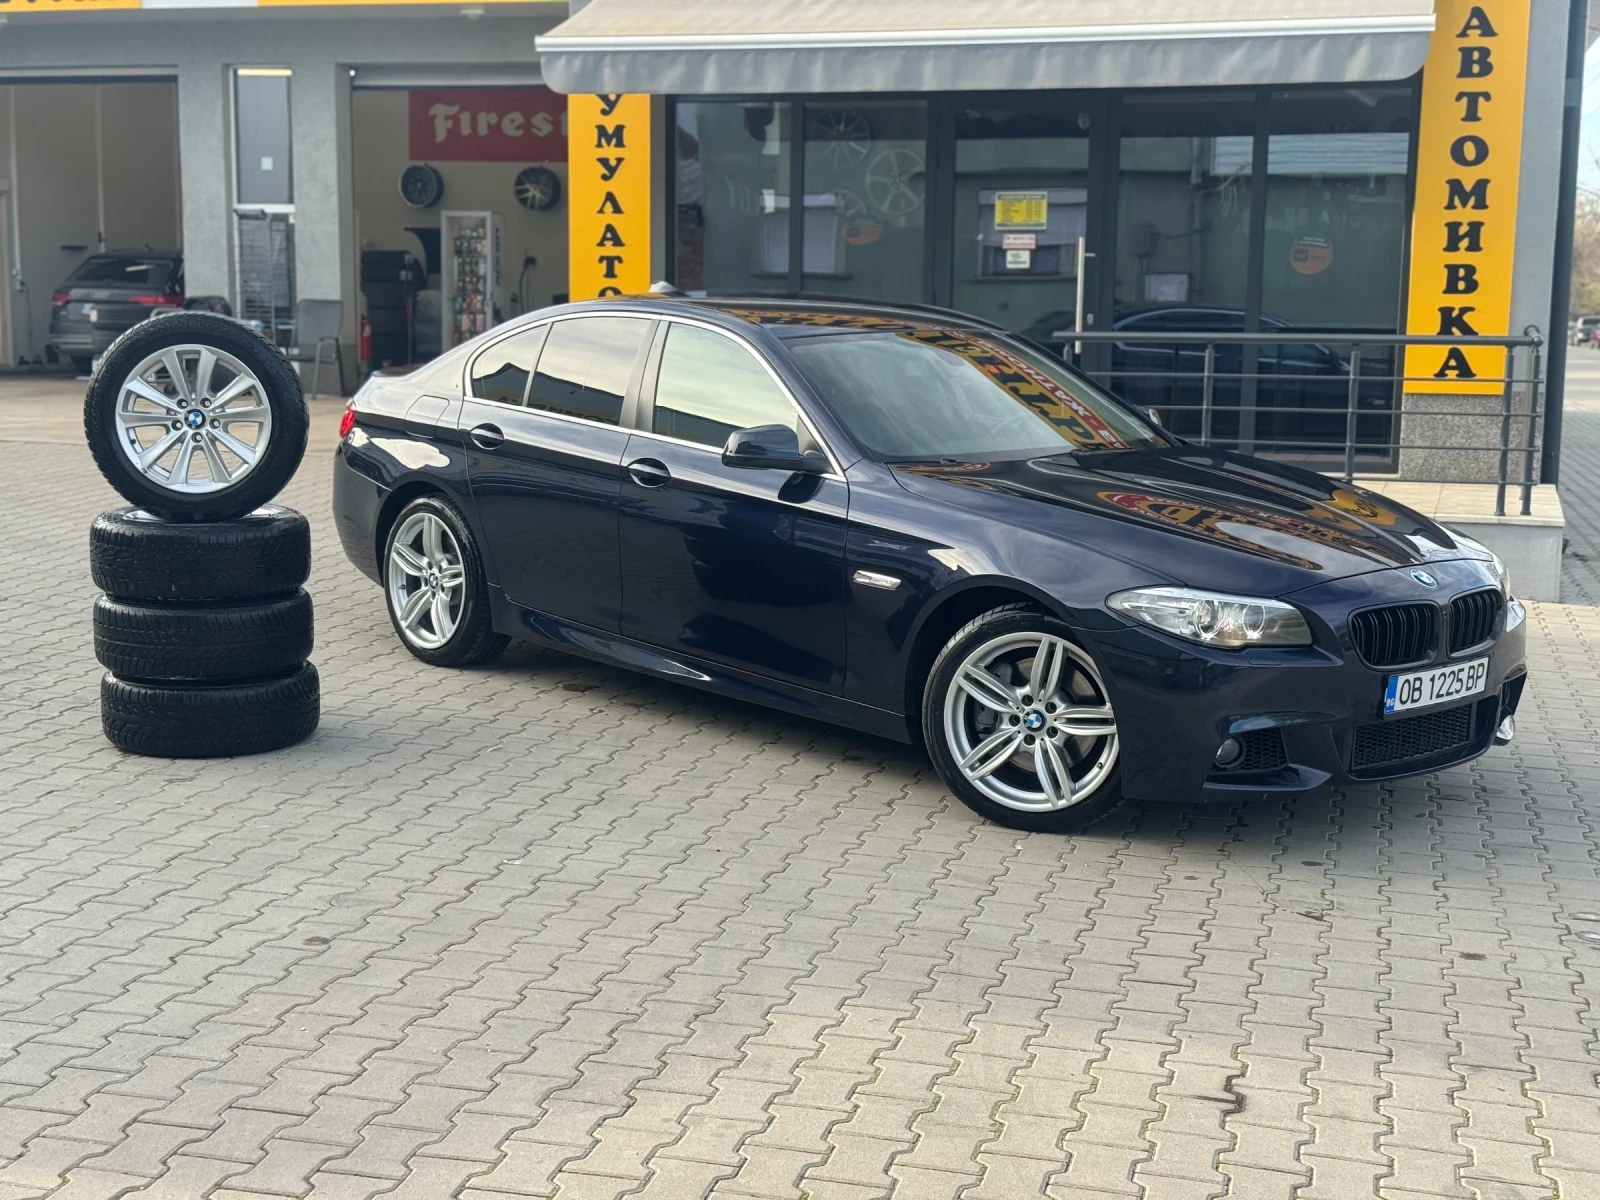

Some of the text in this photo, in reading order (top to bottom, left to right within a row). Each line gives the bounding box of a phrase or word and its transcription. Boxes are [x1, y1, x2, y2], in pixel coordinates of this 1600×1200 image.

[1433, 6, 1498, 378] АВТОМИВКА
[1399, 662, 1485, 705] OB 1225 BP
